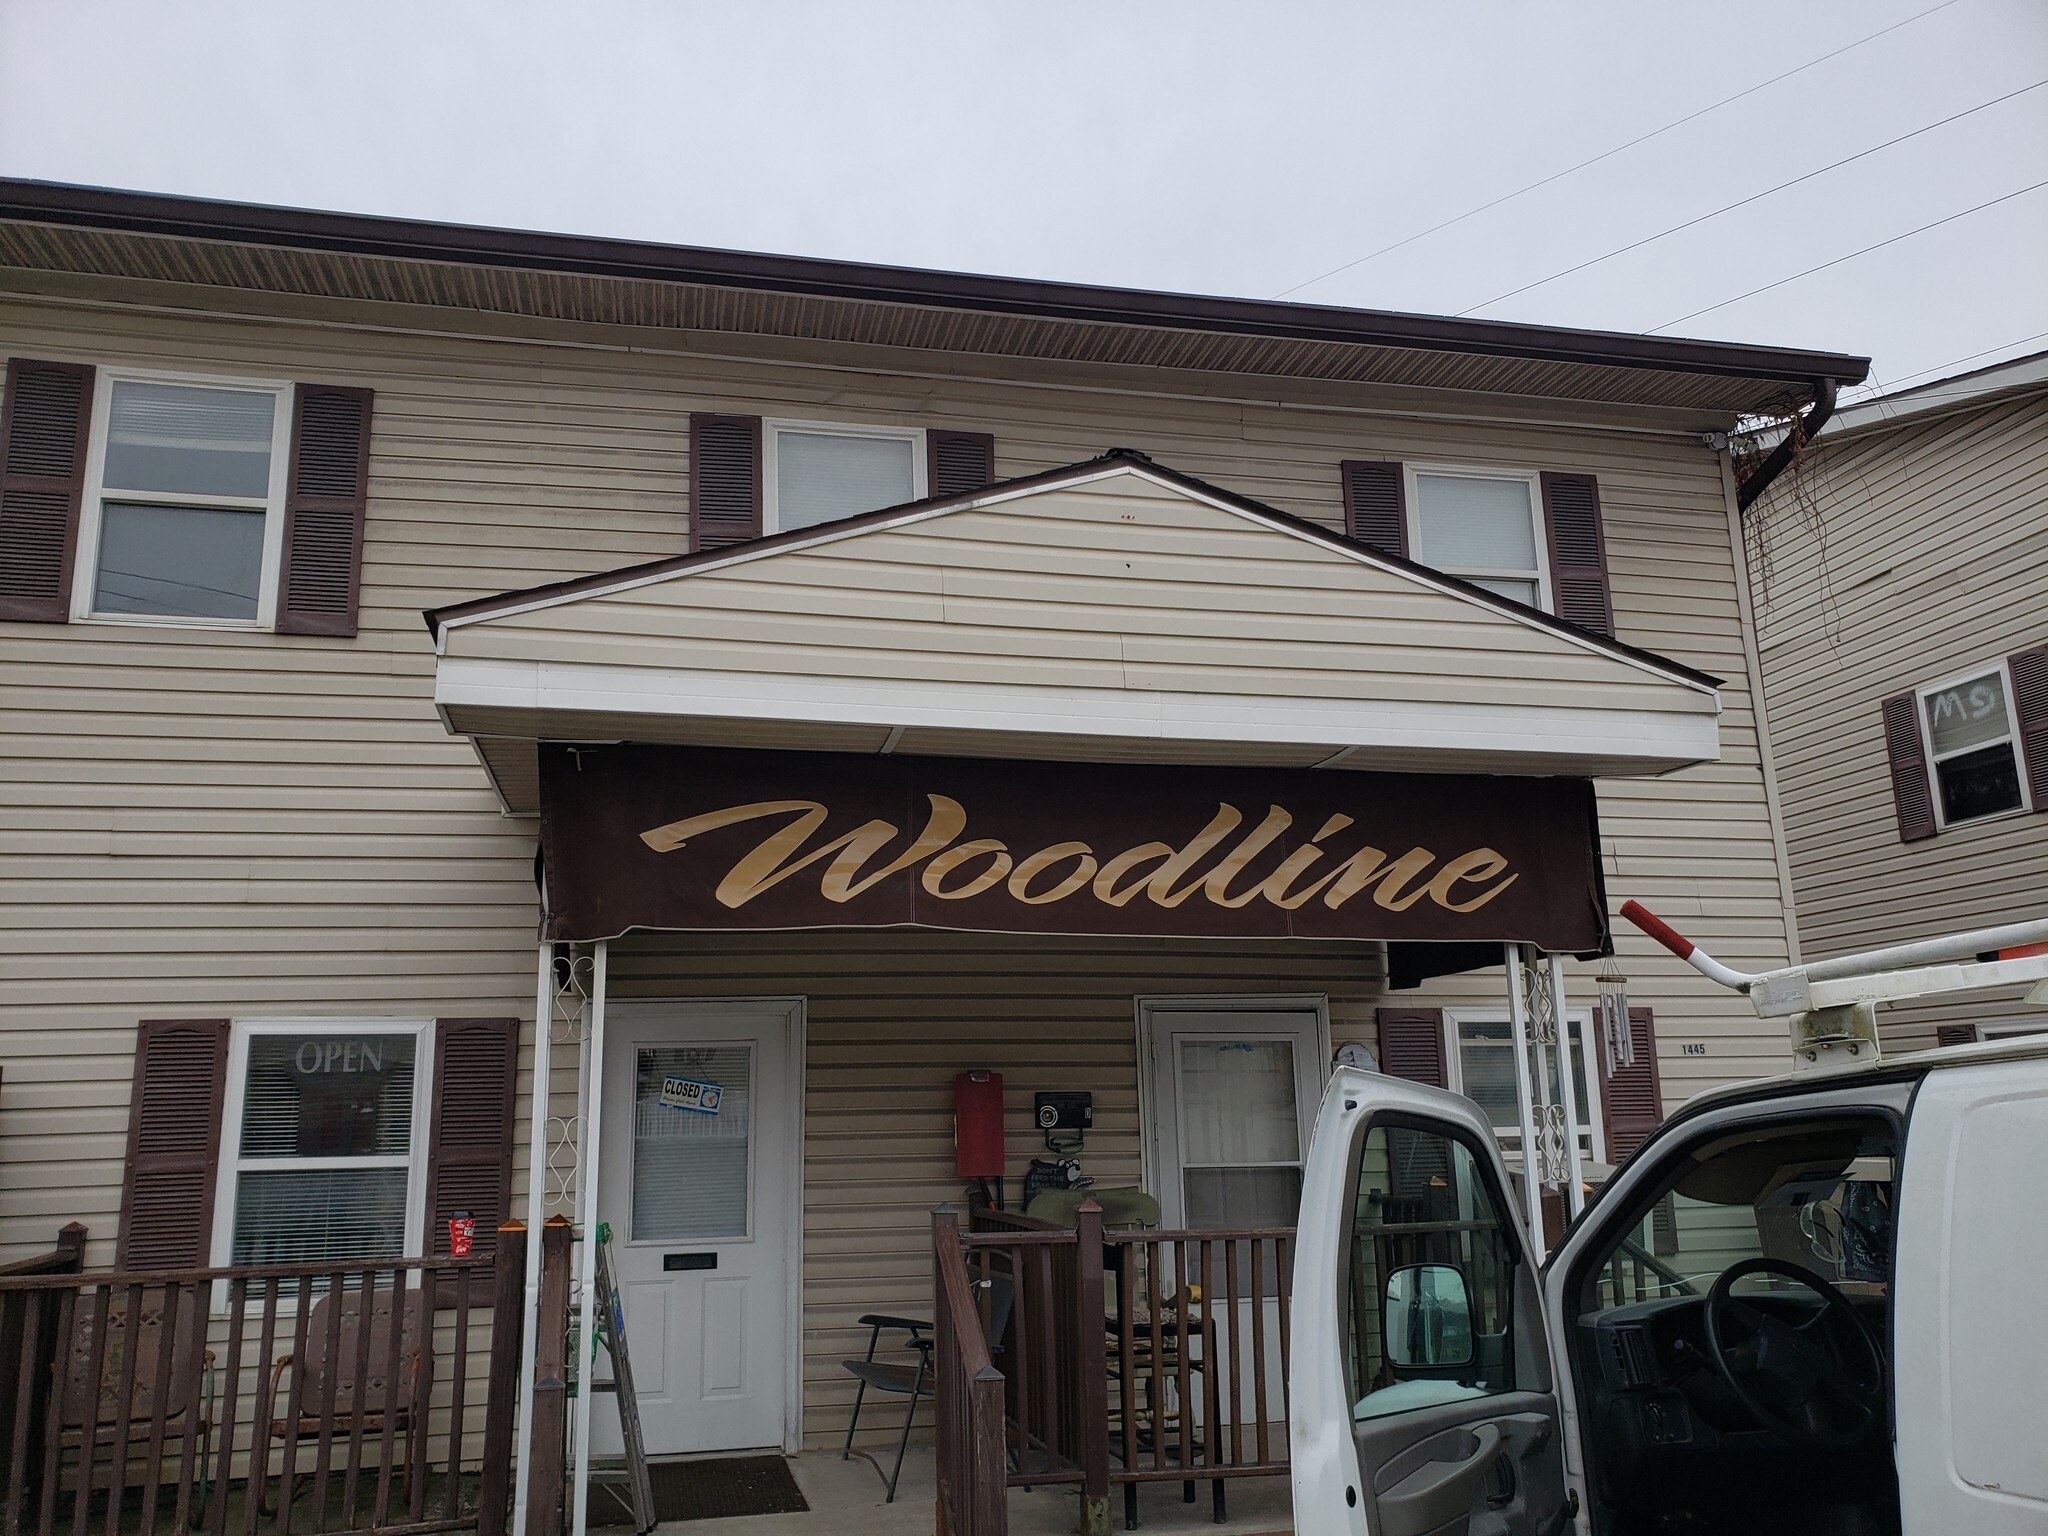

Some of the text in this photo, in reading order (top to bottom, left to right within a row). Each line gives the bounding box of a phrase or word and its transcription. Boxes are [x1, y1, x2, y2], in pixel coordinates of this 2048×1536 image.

[639, 794, 1519, 913] Woodline
[295, 1041, 383, 1074] OPEN
[1682, 1044, 1705, 1055] 1445
[664, 1080, 700, 1098] CLOSED
